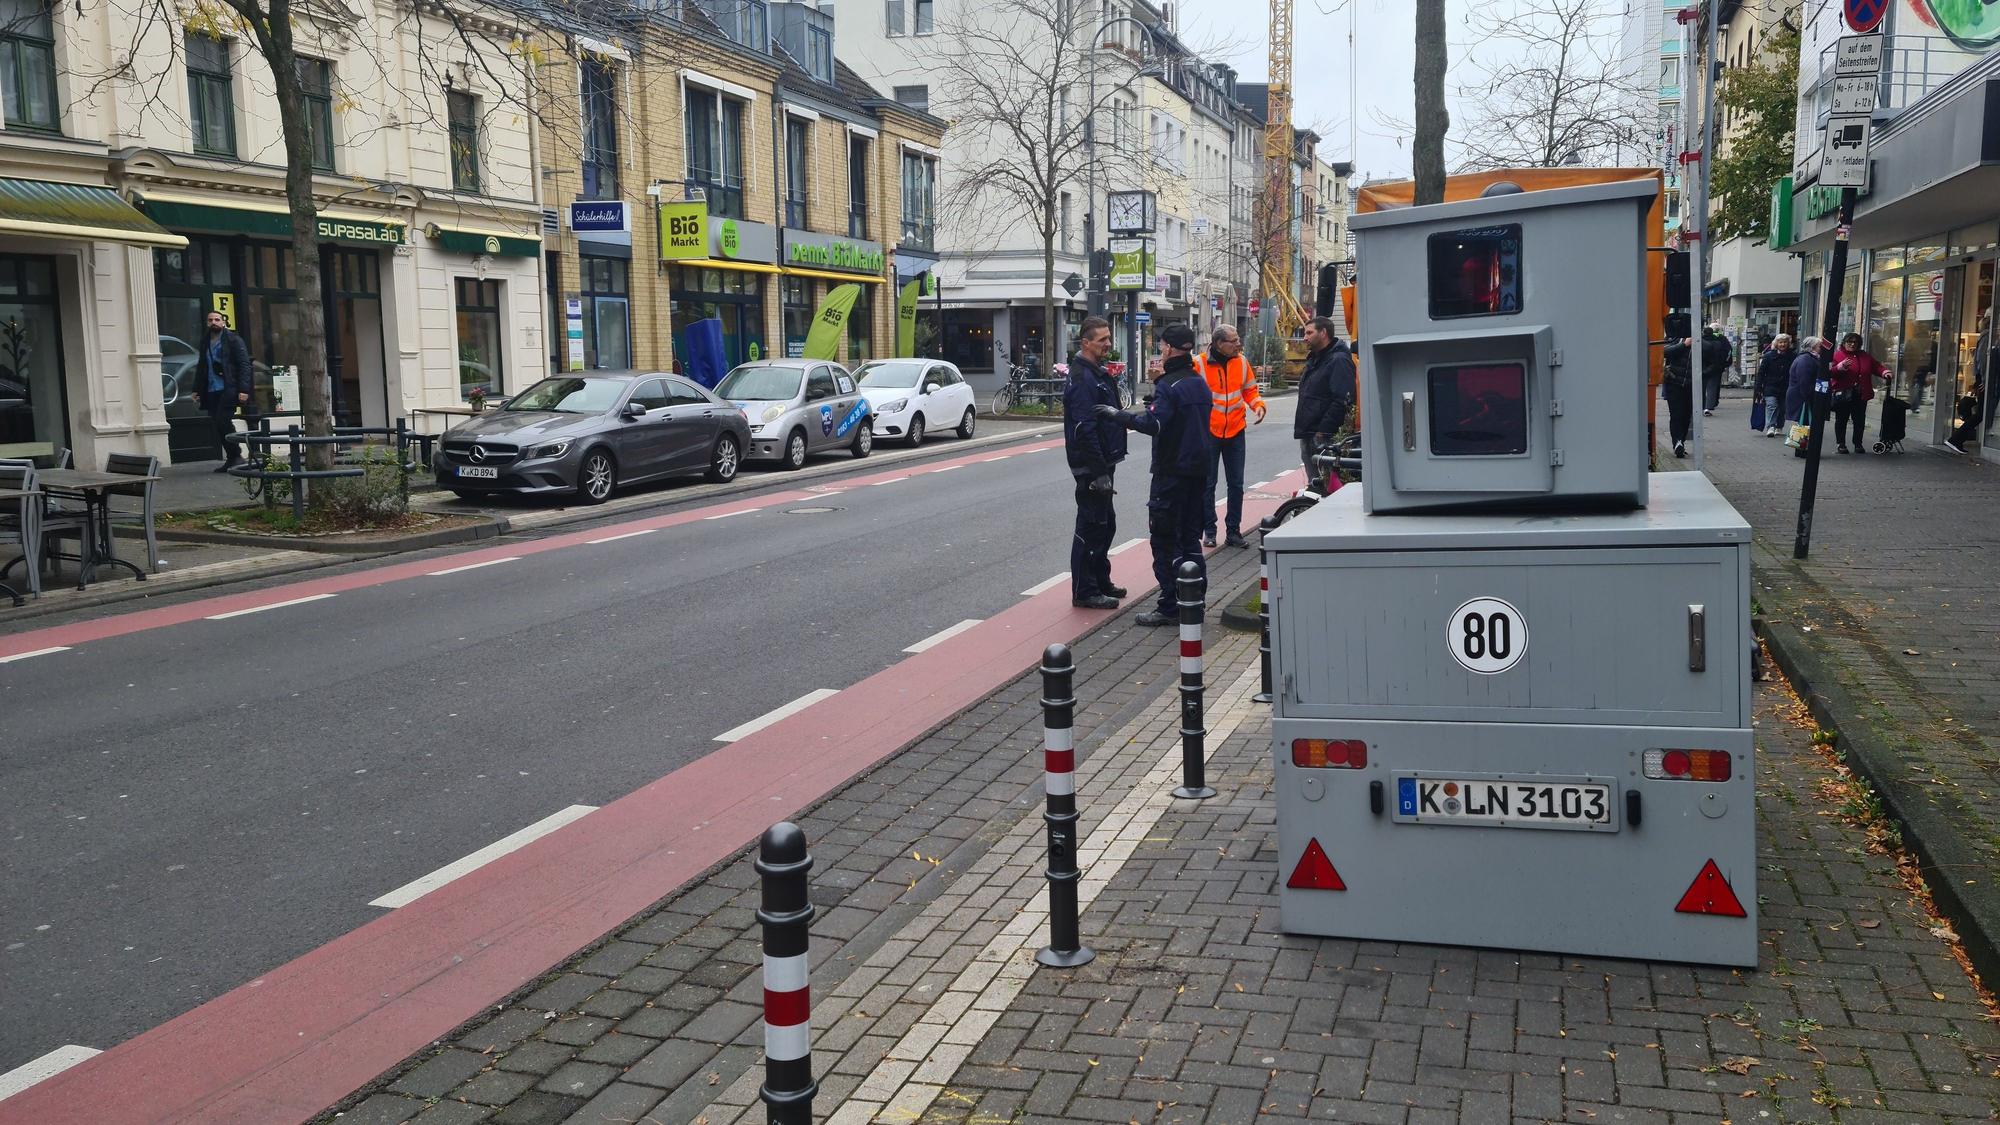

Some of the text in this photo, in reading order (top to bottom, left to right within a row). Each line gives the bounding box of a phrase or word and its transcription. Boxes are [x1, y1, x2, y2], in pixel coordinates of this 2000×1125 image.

[1848, 42, 1873, 54] auf dem
[1838, 56, 1878, 68] Seitenstreifen
[575, 208, 621, 223] Schülerhilfe!
[670, 215, 699, 235] Bio
[670, 236, 700, 247] Markt
[791, 241, 829, 265] Denns
[480, 468, 494, 477] 894
[1463, 611, 1511, 660] 80
[1404, 783, 1605, 819] D K LN 3103
